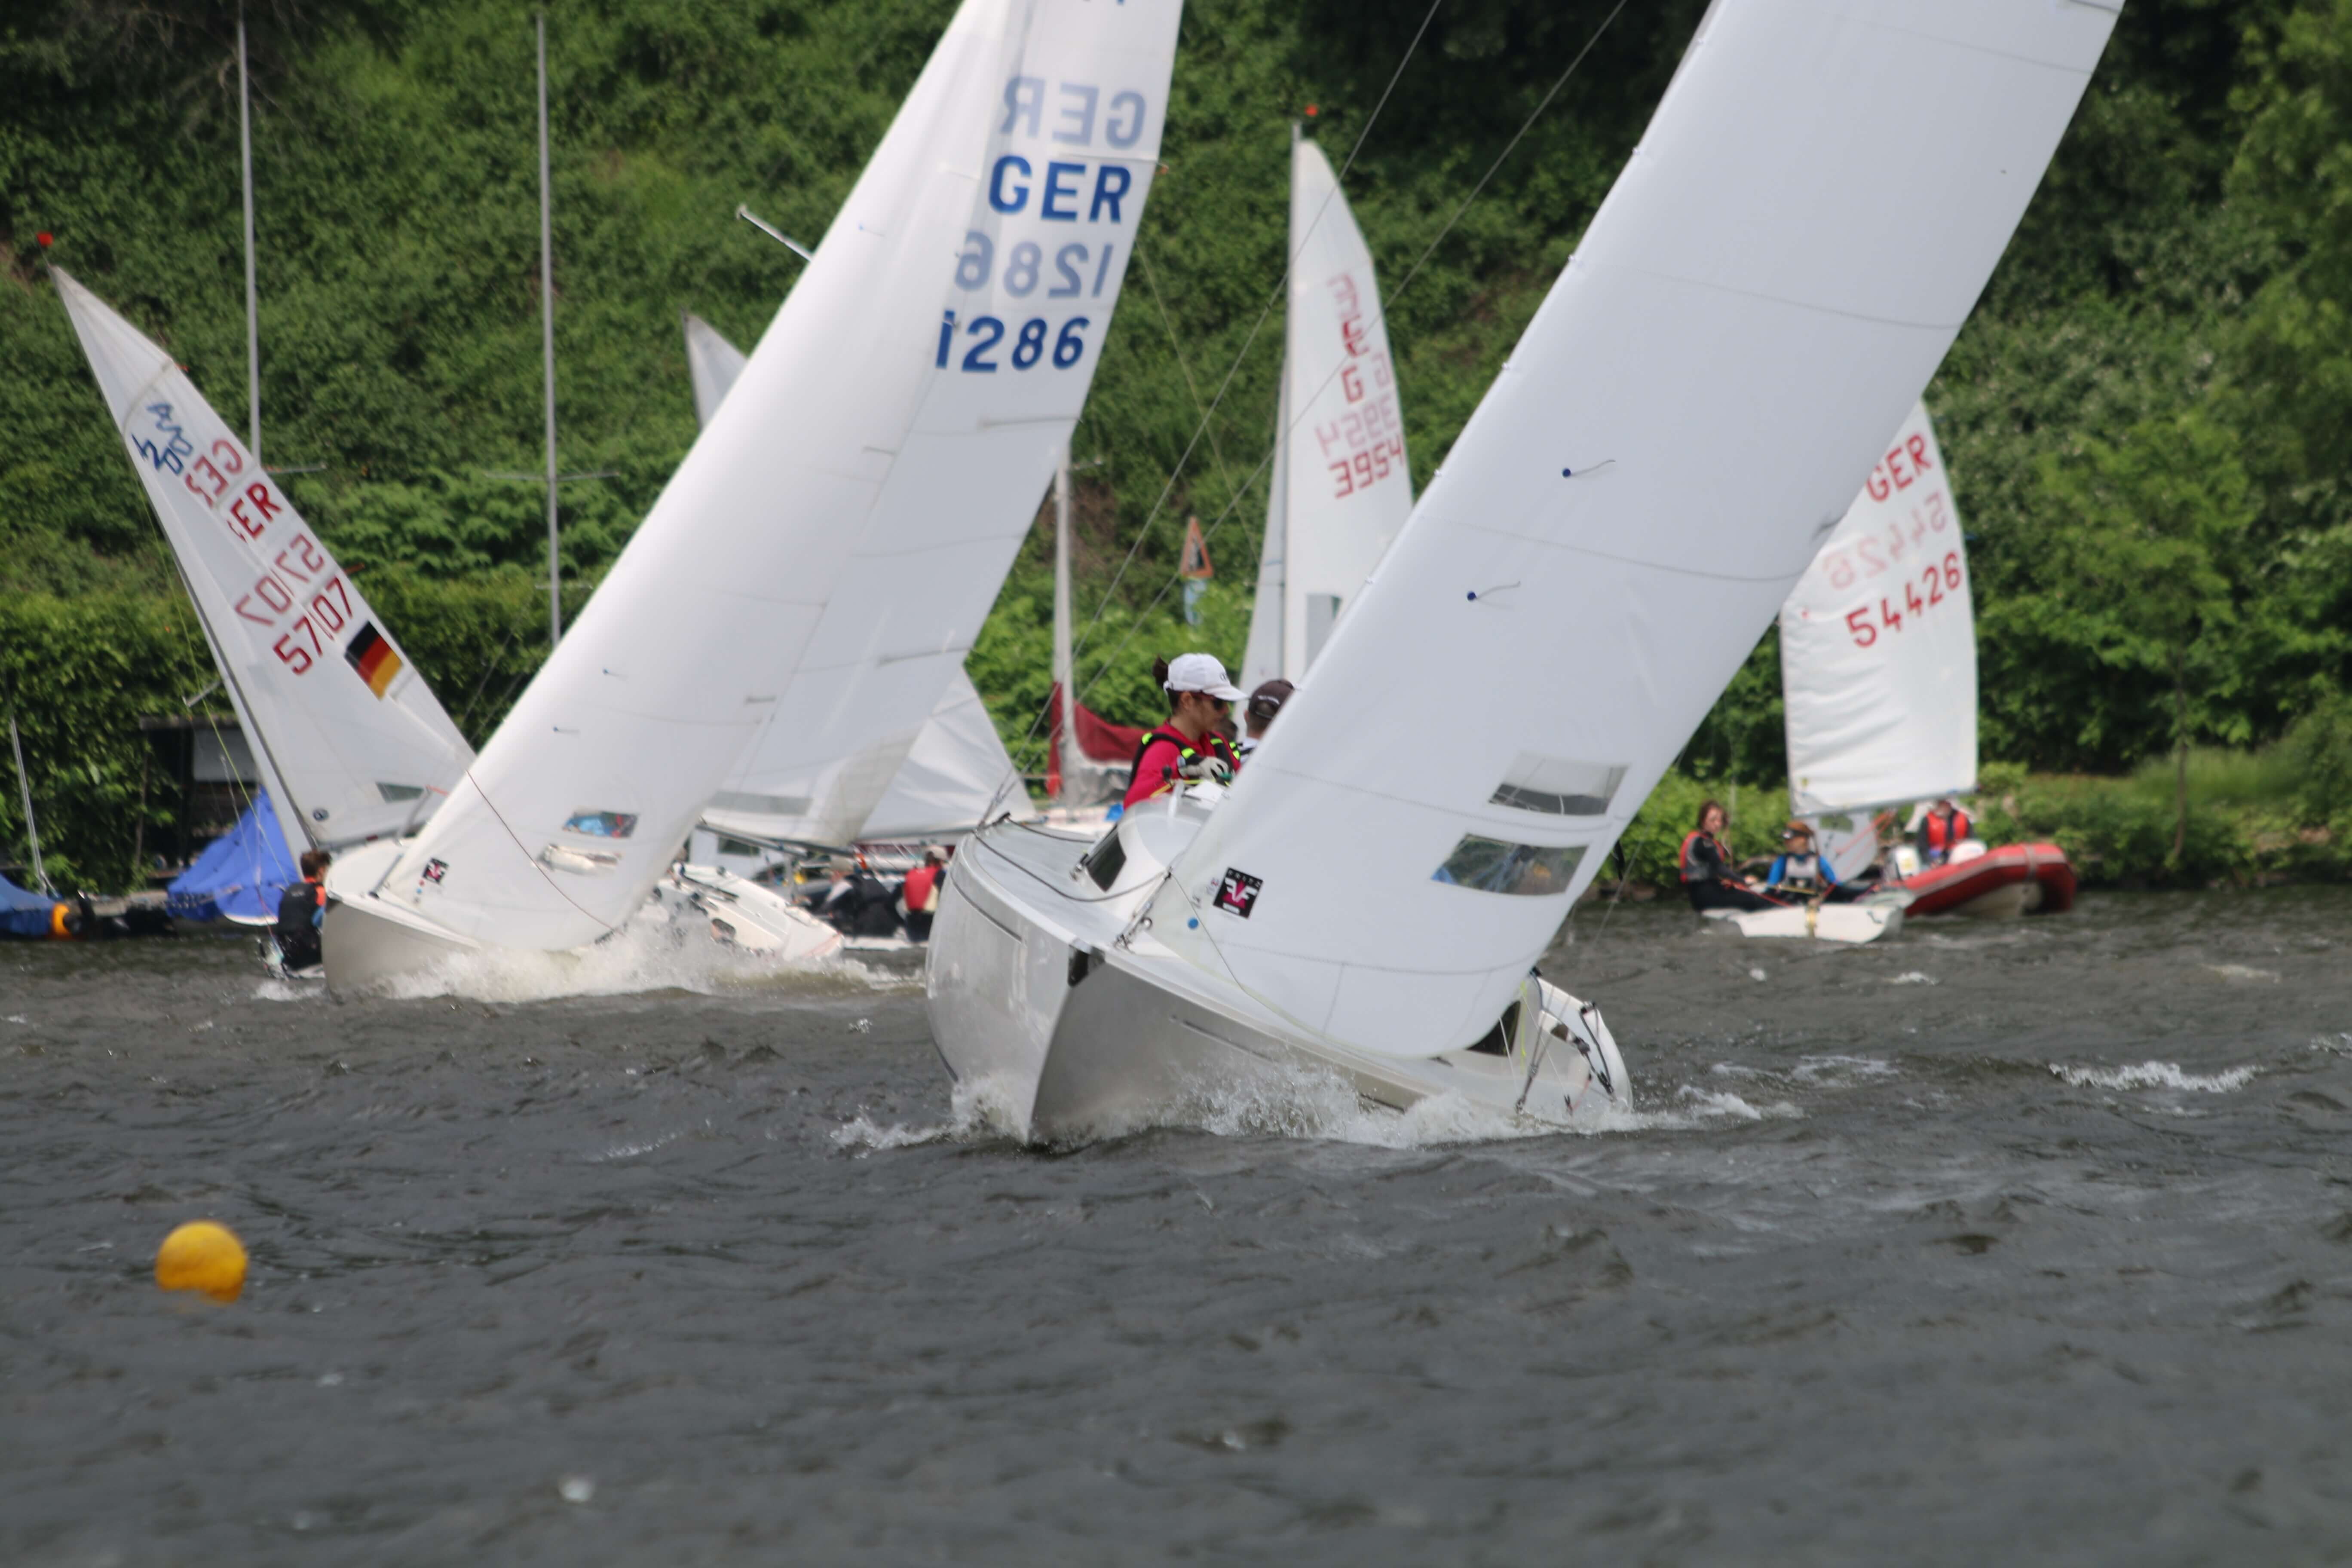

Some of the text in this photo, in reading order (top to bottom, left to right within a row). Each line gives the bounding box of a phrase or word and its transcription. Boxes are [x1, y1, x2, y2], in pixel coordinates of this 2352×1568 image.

[988, 154, 1131, 224] GER
[935, 309, 1090, 373] 1286
[1329, 434, 1405, 499] 3954
[1866, 434, 1932, 502] GER
[1844, 551, 1962, 649] 54426
